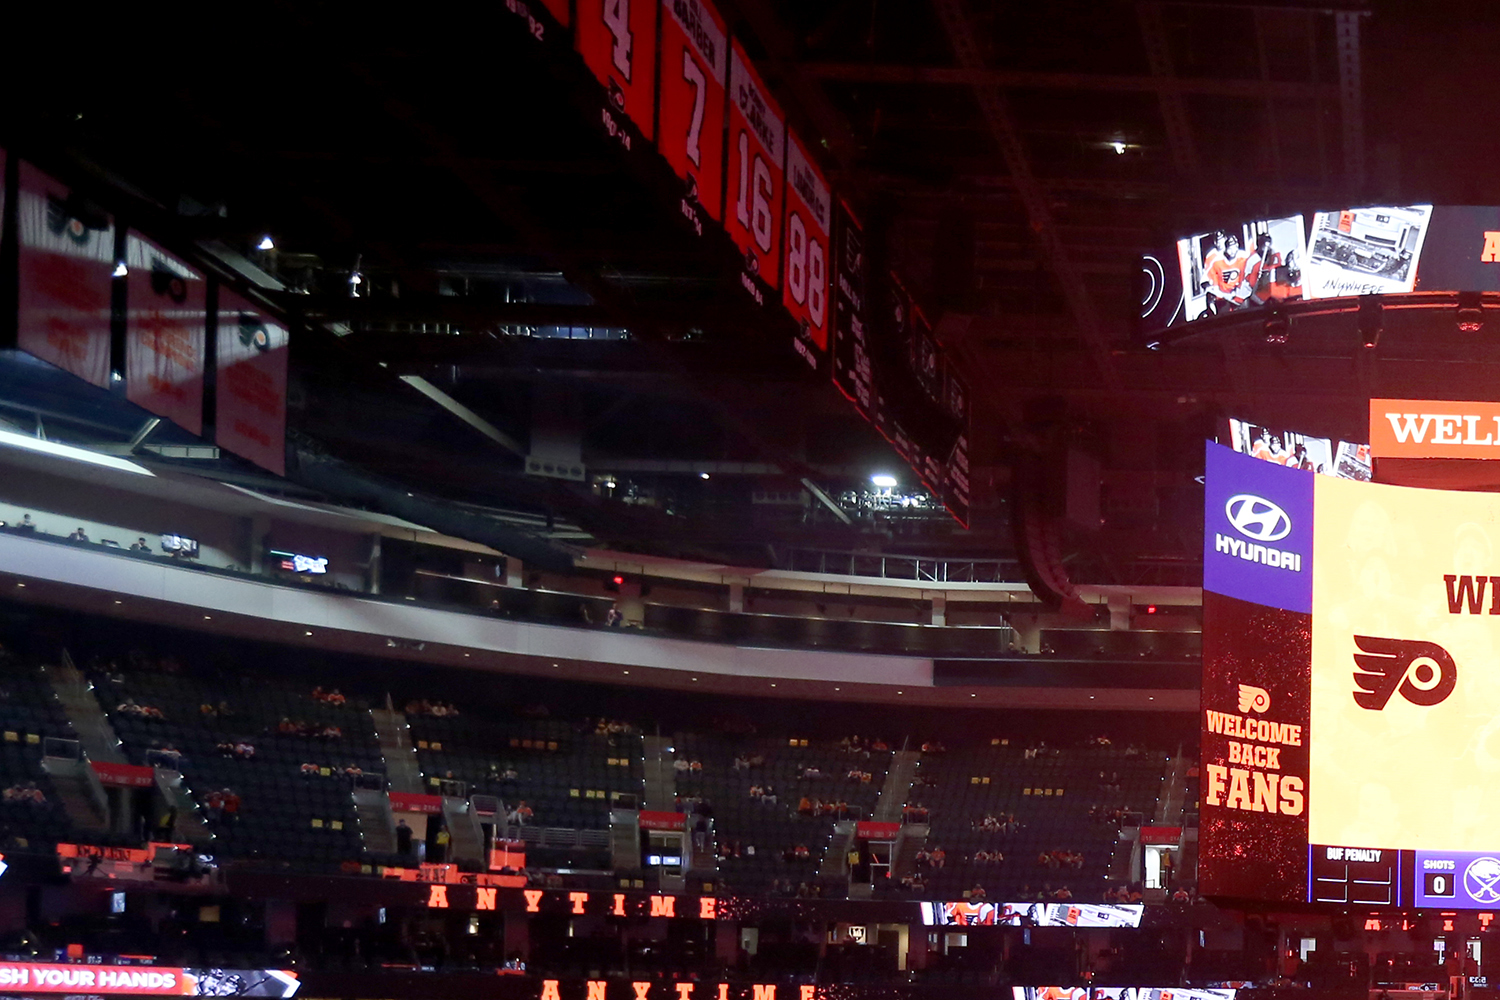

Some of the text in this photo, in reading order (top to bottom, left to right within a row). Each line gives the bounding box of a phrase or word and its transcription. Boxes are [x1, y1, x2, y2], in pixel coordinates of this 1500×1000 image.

[684, 50, 706, 168] 7
[736, 130, 773, 256] 16
[788, 211, 827, 330] 88
[1215, 533, 1301, 572] HYUNDAI
[1206, 709, 1302, 746] WELCOME
[1229, 740, 1280, 770] BACK
[1206, 764, 1303, 816] FANS
[1327, 847, 1381, 863] BUF PENALTY
[1423, 860, 1455, 870] SHOTS
[428, 885, 716, 919] ANYTIME
[1433, 876, 1446, 893] 0
[36, 968, 95, 986] YOUR
[98, 970, 176, 989] HANDS
